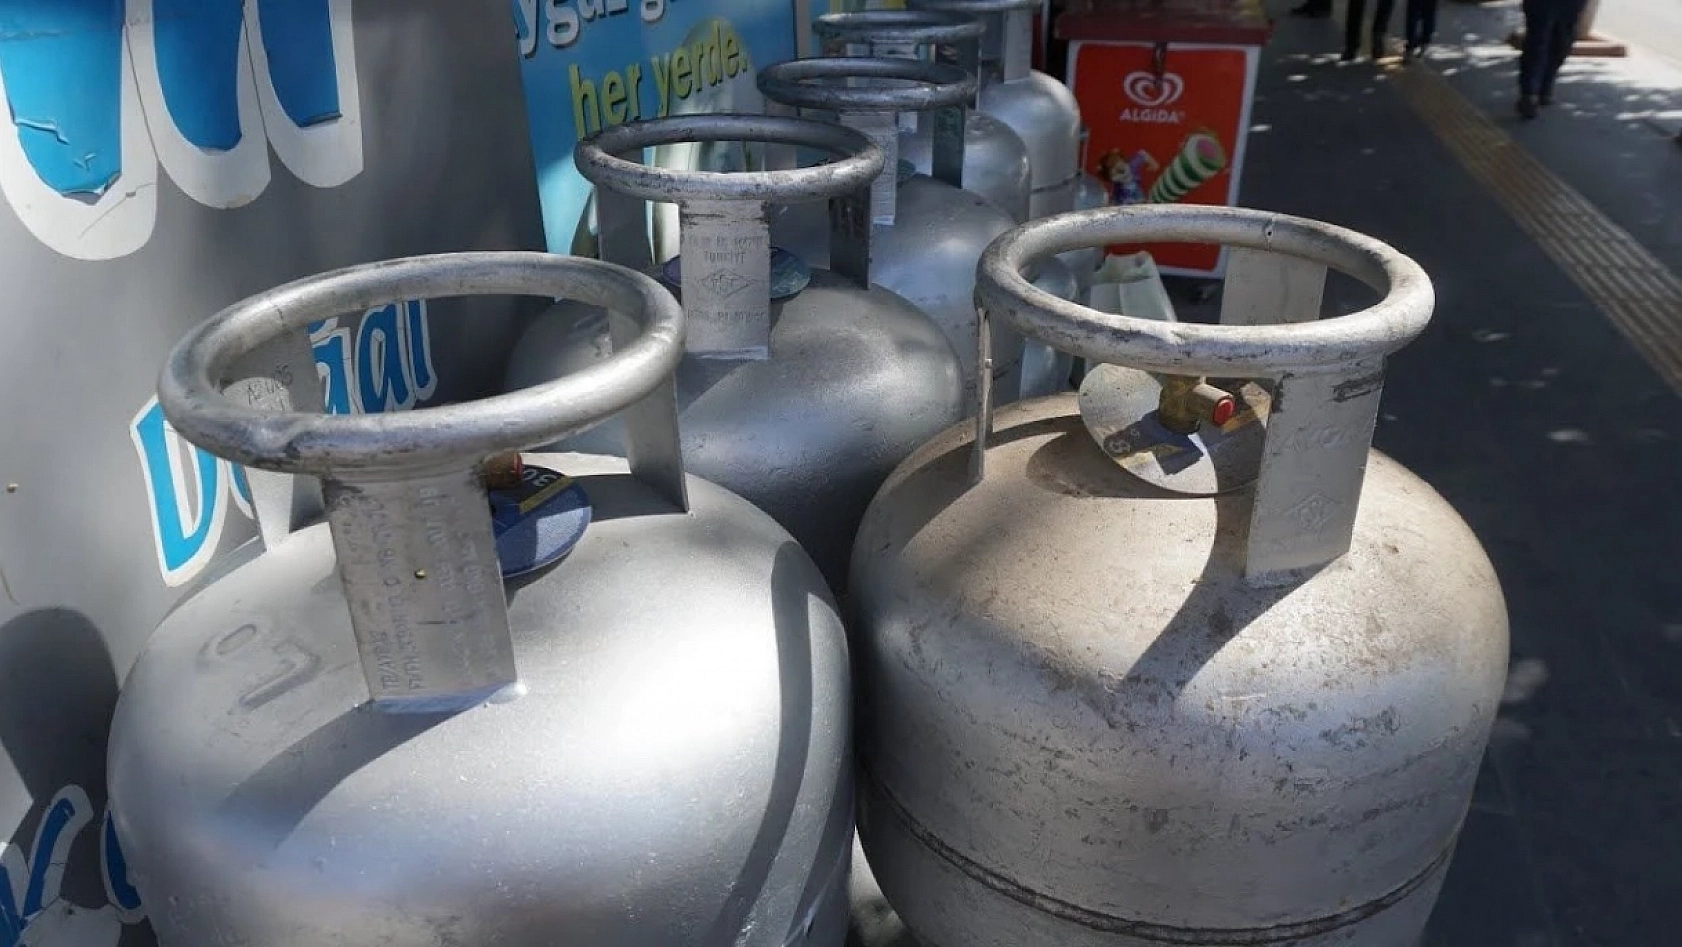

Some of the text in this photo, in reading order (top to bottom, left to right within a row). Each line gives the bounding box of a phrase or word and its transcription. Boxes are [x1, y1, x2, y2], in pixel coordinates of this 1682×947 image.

[568, 62, 642, 140] her
[650, 19, 748, 118] yerde.
[1119, 108, 1179, 123] ALGIDA
